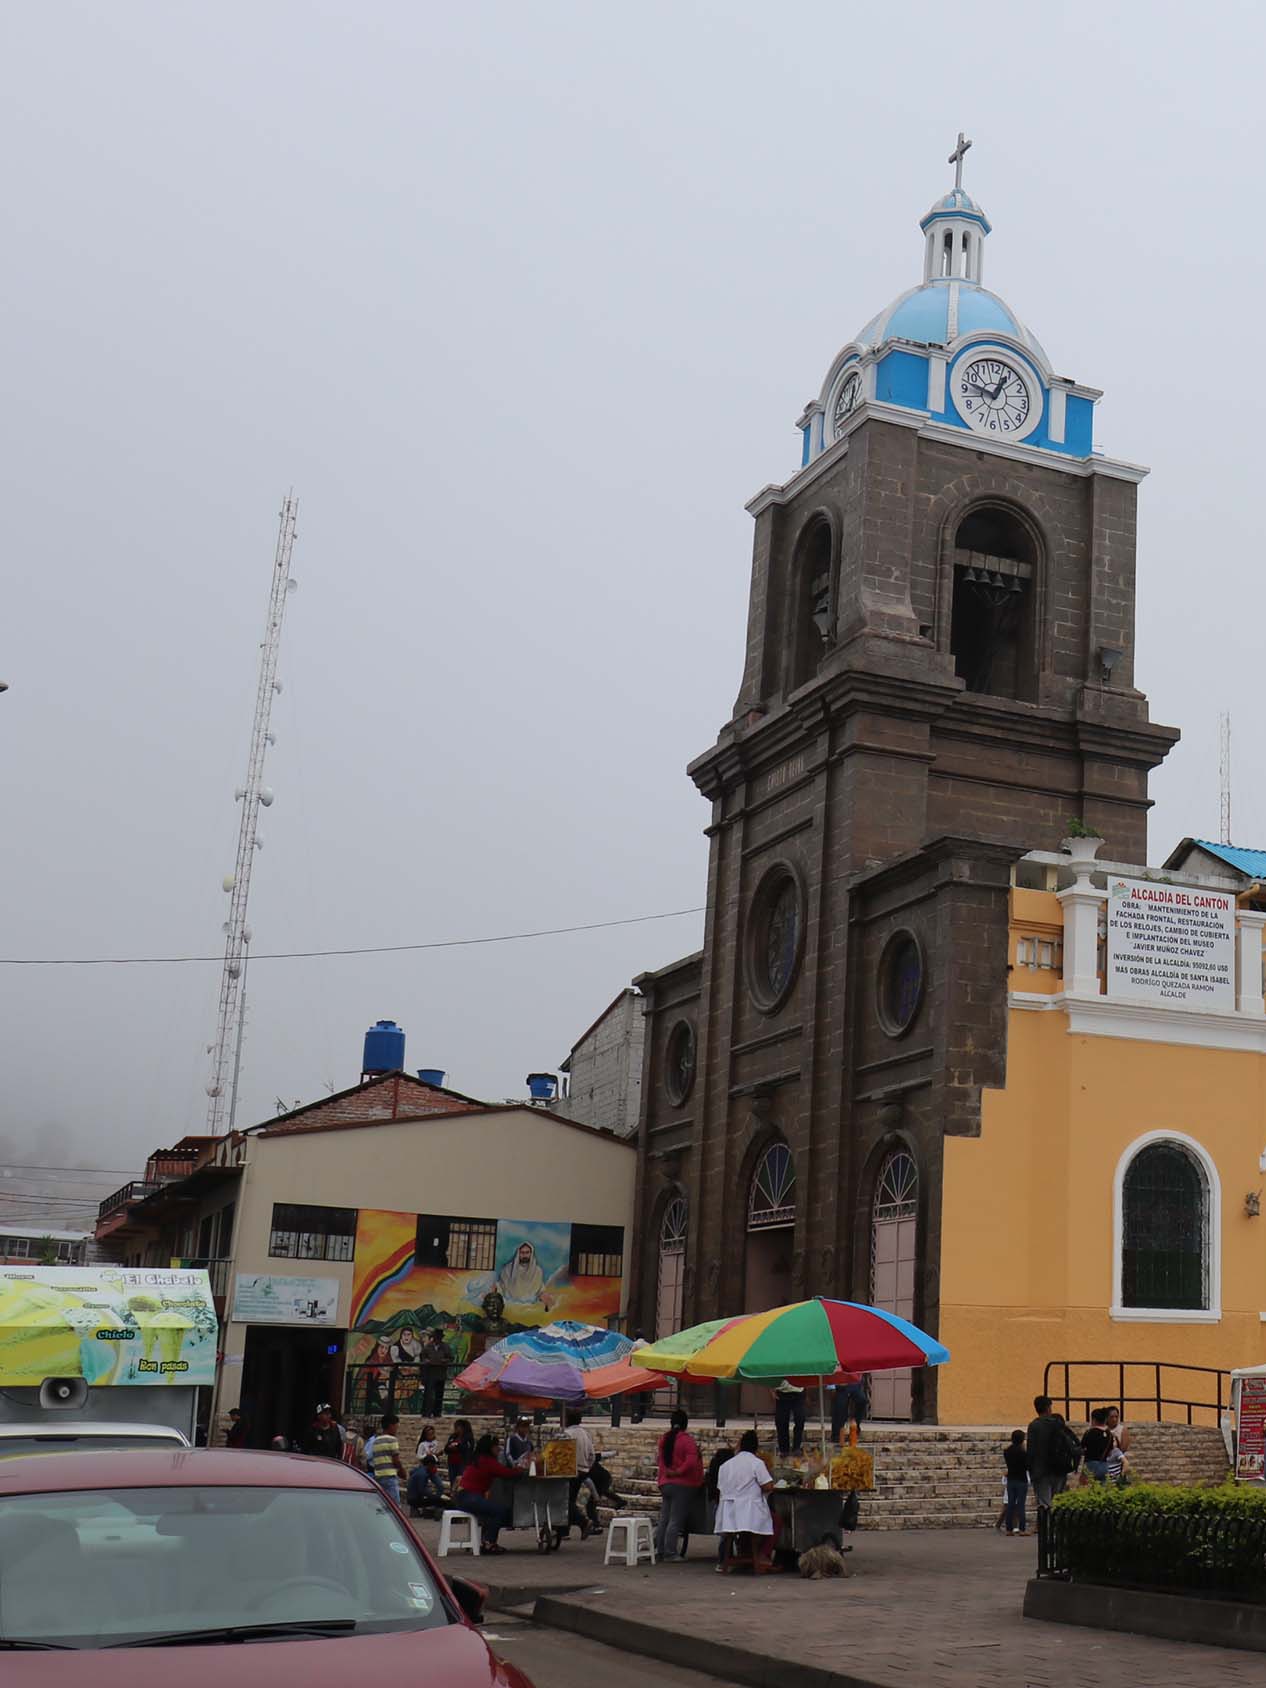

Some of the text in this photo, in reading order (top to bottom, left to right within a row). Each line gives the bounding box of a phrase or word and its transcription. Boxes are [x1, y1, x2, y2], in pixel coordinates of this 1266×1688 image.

[976, 364, 986, 375] 11
[990, 363, 1000, 374] 12
[966, 372, 978, 383] 10
[961, 384, 968, 394] 9
[1016, 384, 1023, 394] 2
[966, 400, 972, 410] 8
[1020, 399, 1026, 410] 3
[978, 412, 984, 422] 7
[1015, 413, 1022, 424] 4
[989, 420, 996, 430] 6
[1003, 420, 1010, 430] 5
[1131, 888, 1228, 910] ALCALDÍA DEL CANTÓN
[1122, 901, 1141, 910] OBRA:
[1148, 904, 1199, 917] MANTENIMIENTO
[1116, 910, 1145, 920] FACHADA
[1146, 914, 1176, 924] FRONTAL,
[1110, 920, 1118, 928] DE
[1134, 922, 1164, 933] RELOJES,
[1164, 926, 1189, 936] CAMBIO
[1190, 929, 1199, 937] DE
[1200, 930, 1230, 940] CUBIERTA
[1133, 943, 1155, 952] JAVIER
[1156, 944, 1178, 954] MUÑOZ
[1180, 938, 1192, 946] DEL
[1192, 938, 1214, 949] MUSEO
[1217, 964, 1228, 972] USD
[1130, 967, 1150, 976] OBRAS
[1190, 973, 1208, 982] SANTA
[1210, 975, 1230, 985] ISABEL
[1162, 980, 1190, 990] QUEZADA
[1160, 990, 1186, 998] ALCALDE
